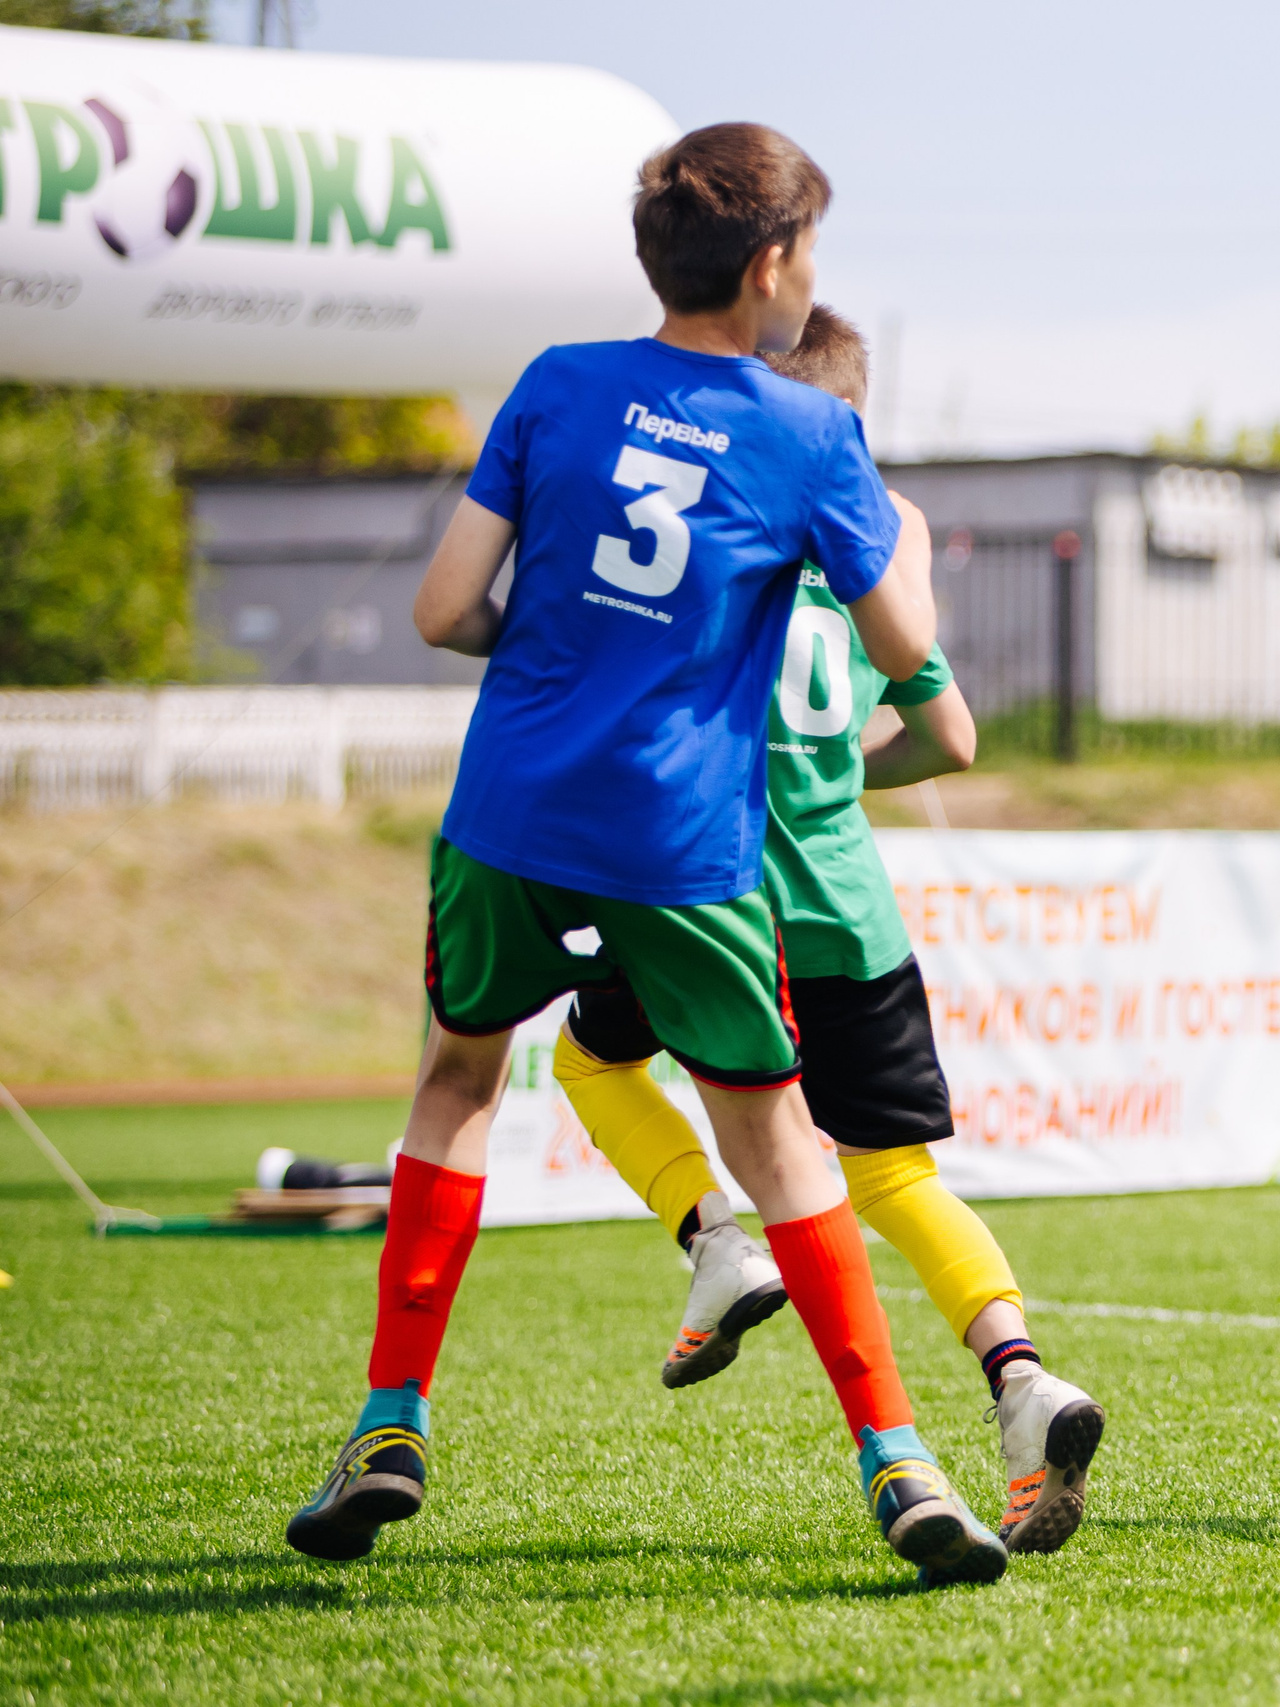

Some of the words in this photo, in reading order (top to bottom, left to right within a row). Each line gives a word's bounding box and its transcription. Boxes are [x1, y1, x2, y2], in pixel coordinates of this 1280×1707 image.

[624, 402, 730, 454] Первые
[592, 445, 708, 597] 3
[583, 591, 673, 624] METROSHKA.RU
[767, 742, 819, 755] OSHKA.RU
